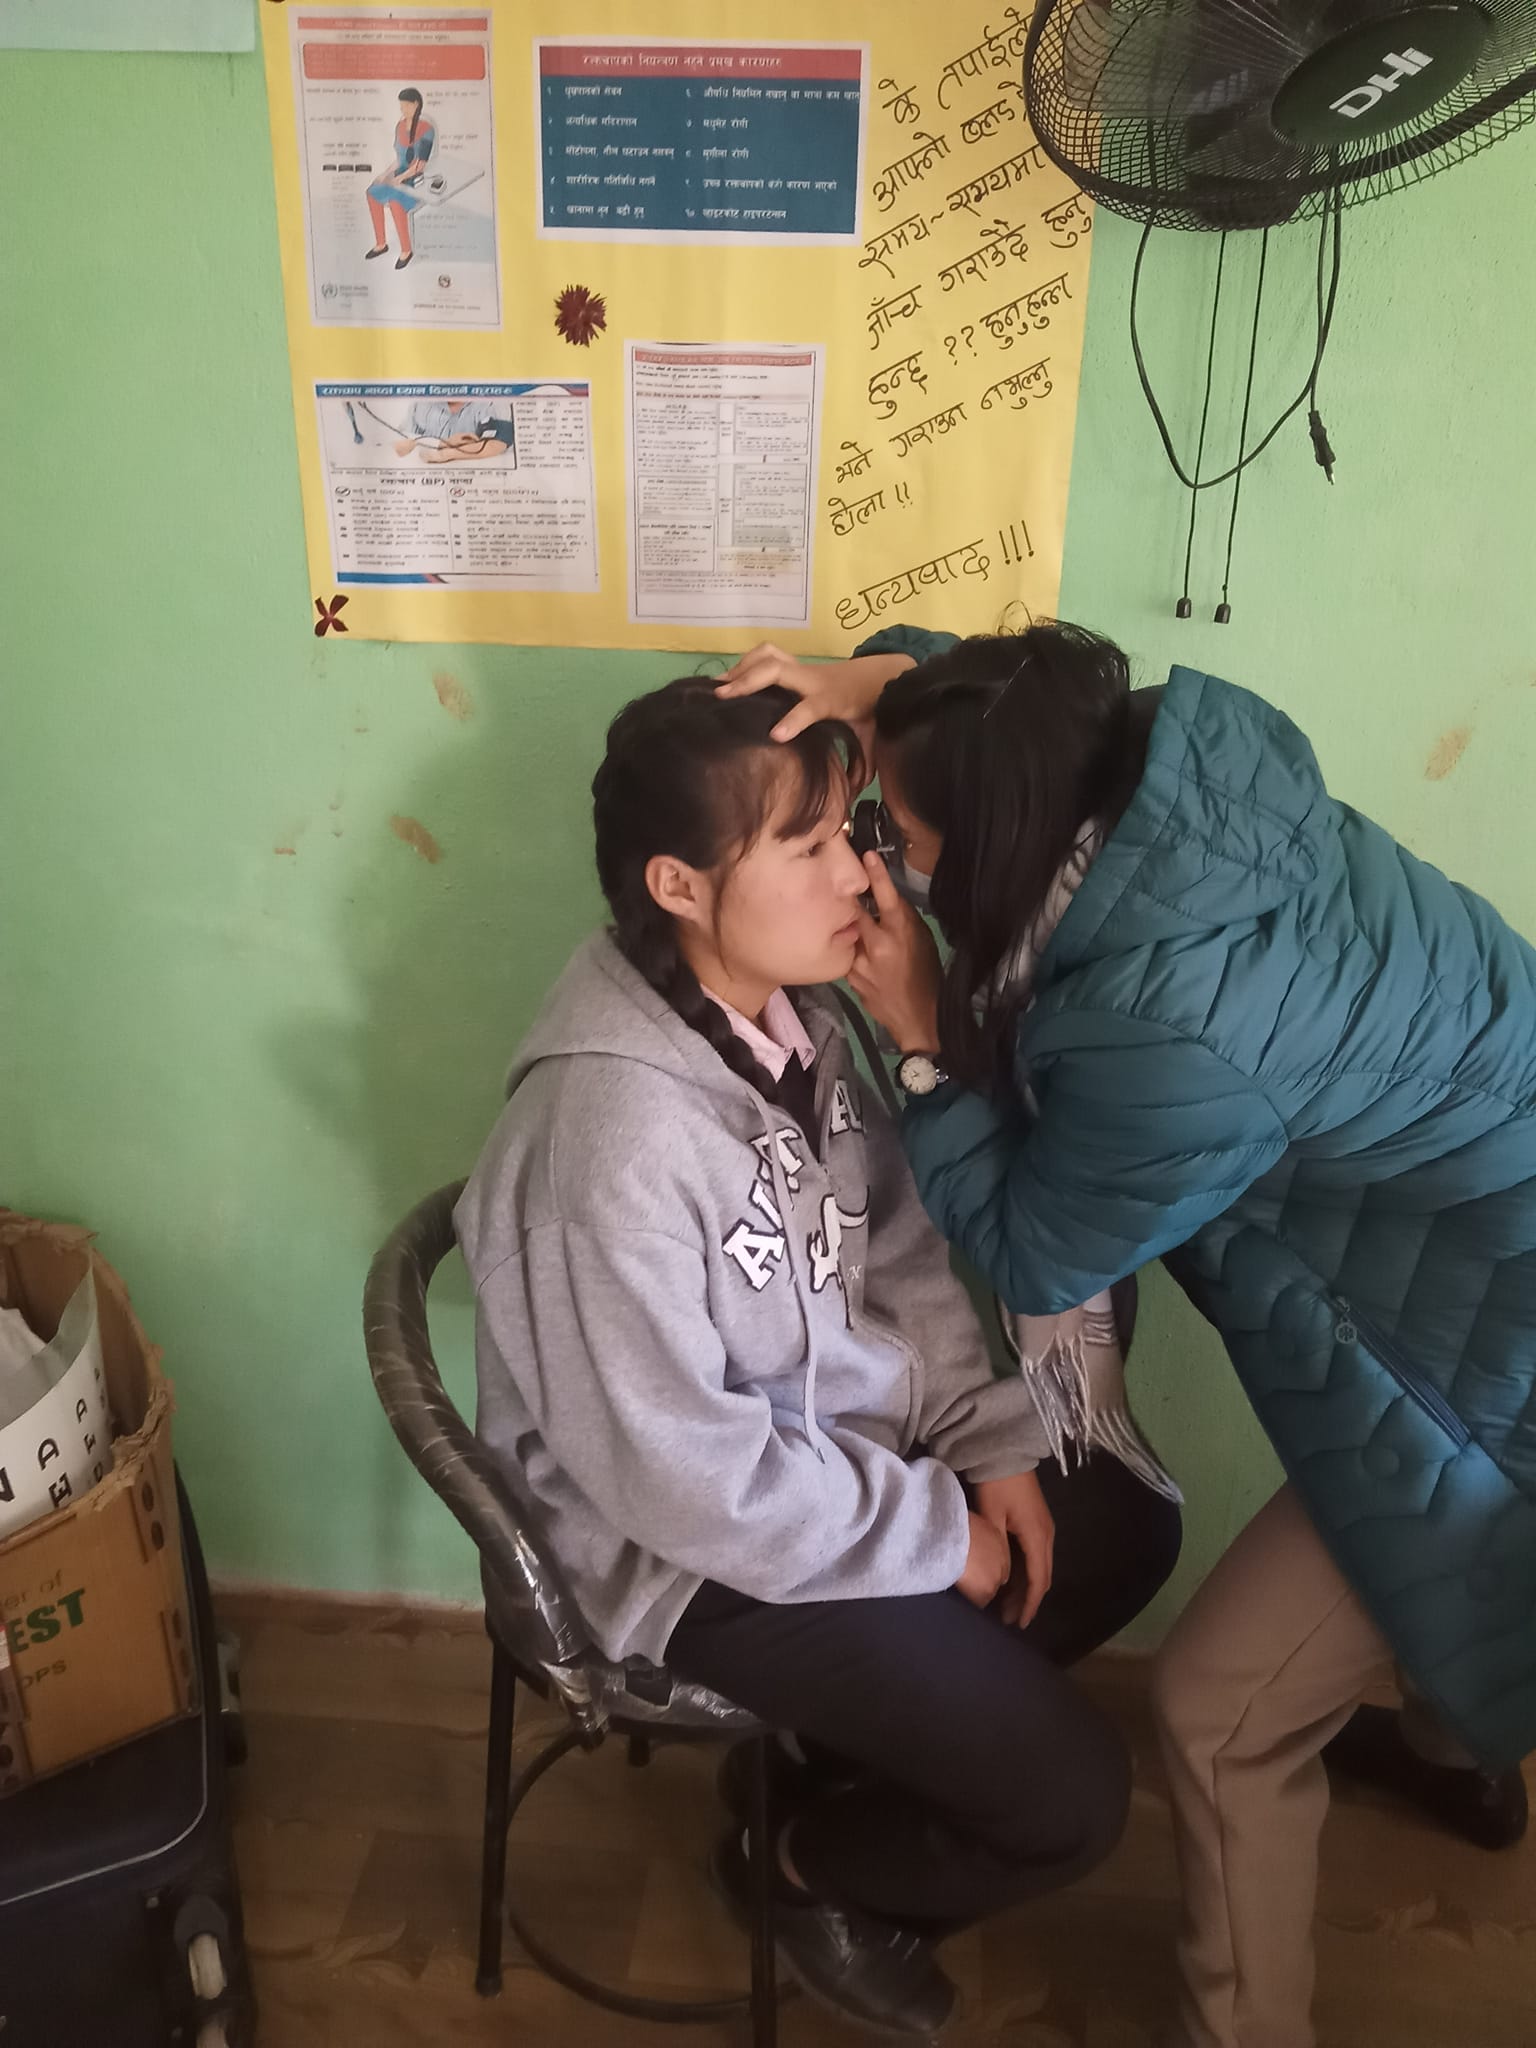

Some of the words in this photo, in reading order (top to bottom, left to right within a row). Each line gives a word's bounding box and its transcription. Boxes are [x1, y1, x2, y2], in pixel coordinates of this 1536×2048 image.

[878, 79, 920, 123] के
[835, 441, 873, 483] भने
[835, 539, 990, 629] धन्यवाद
